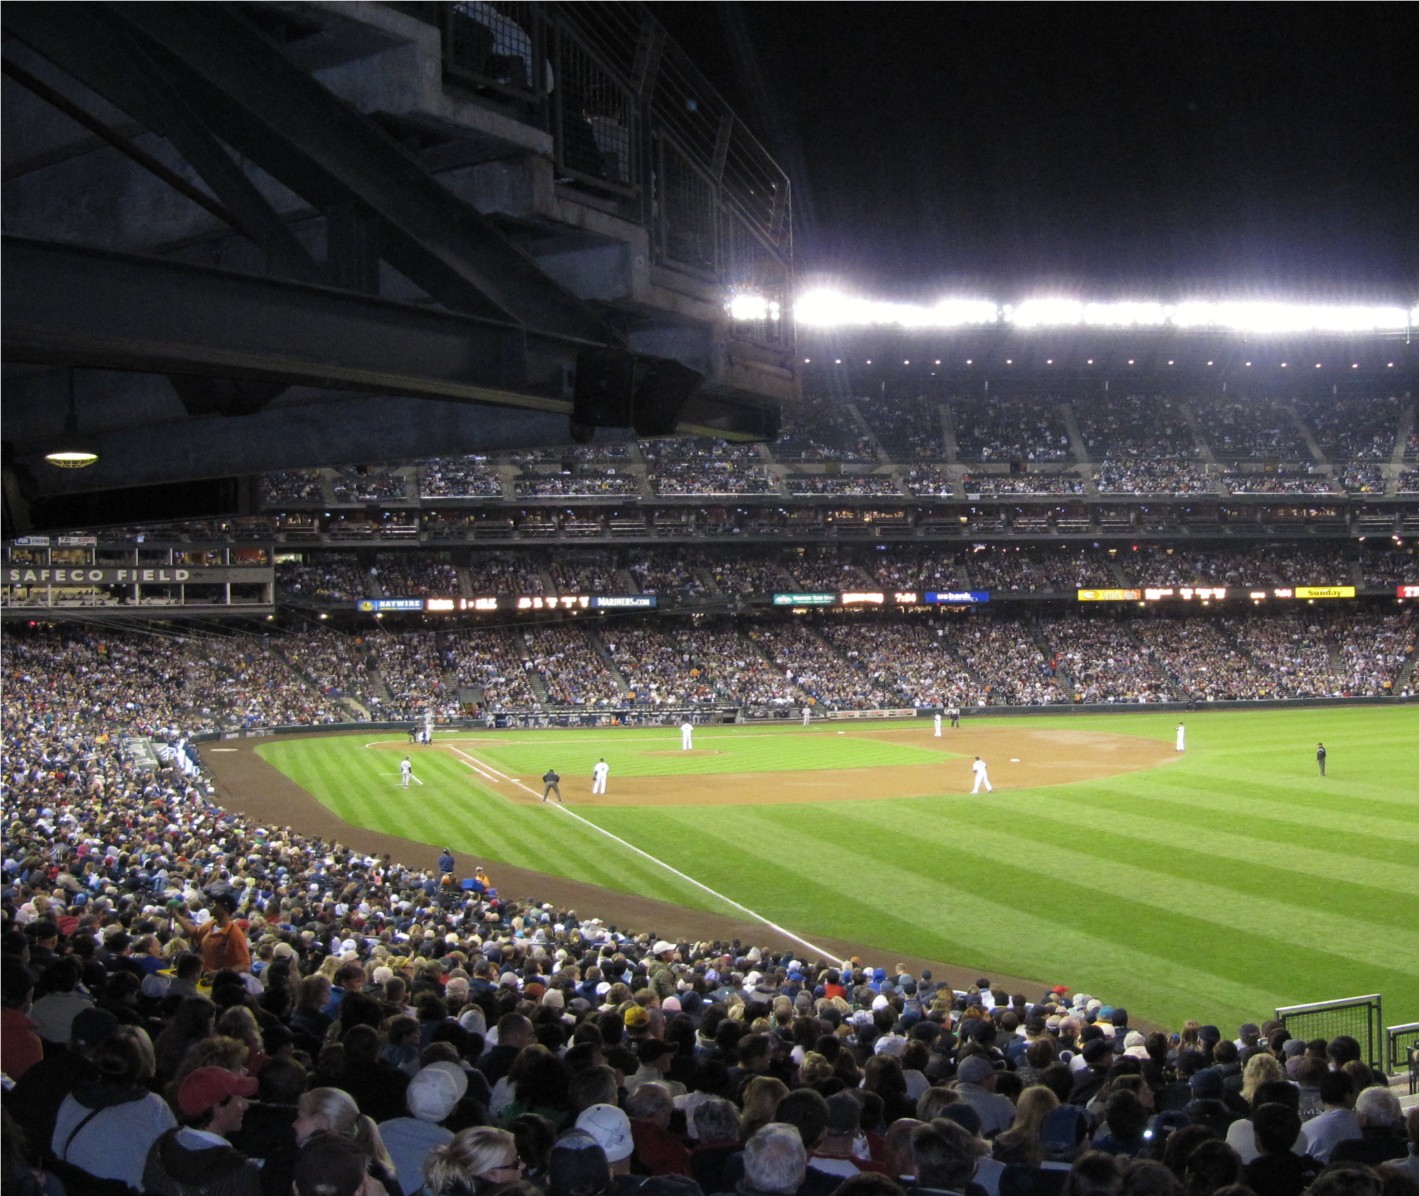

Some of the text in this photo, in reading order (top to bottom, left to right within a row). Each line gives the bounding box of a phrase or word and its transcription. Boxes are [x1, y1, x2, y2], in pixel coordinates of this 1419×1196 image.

[10, 569, 190, 581] SAFECO FIELD
[1308, 589, 1342, 597] Sunday
